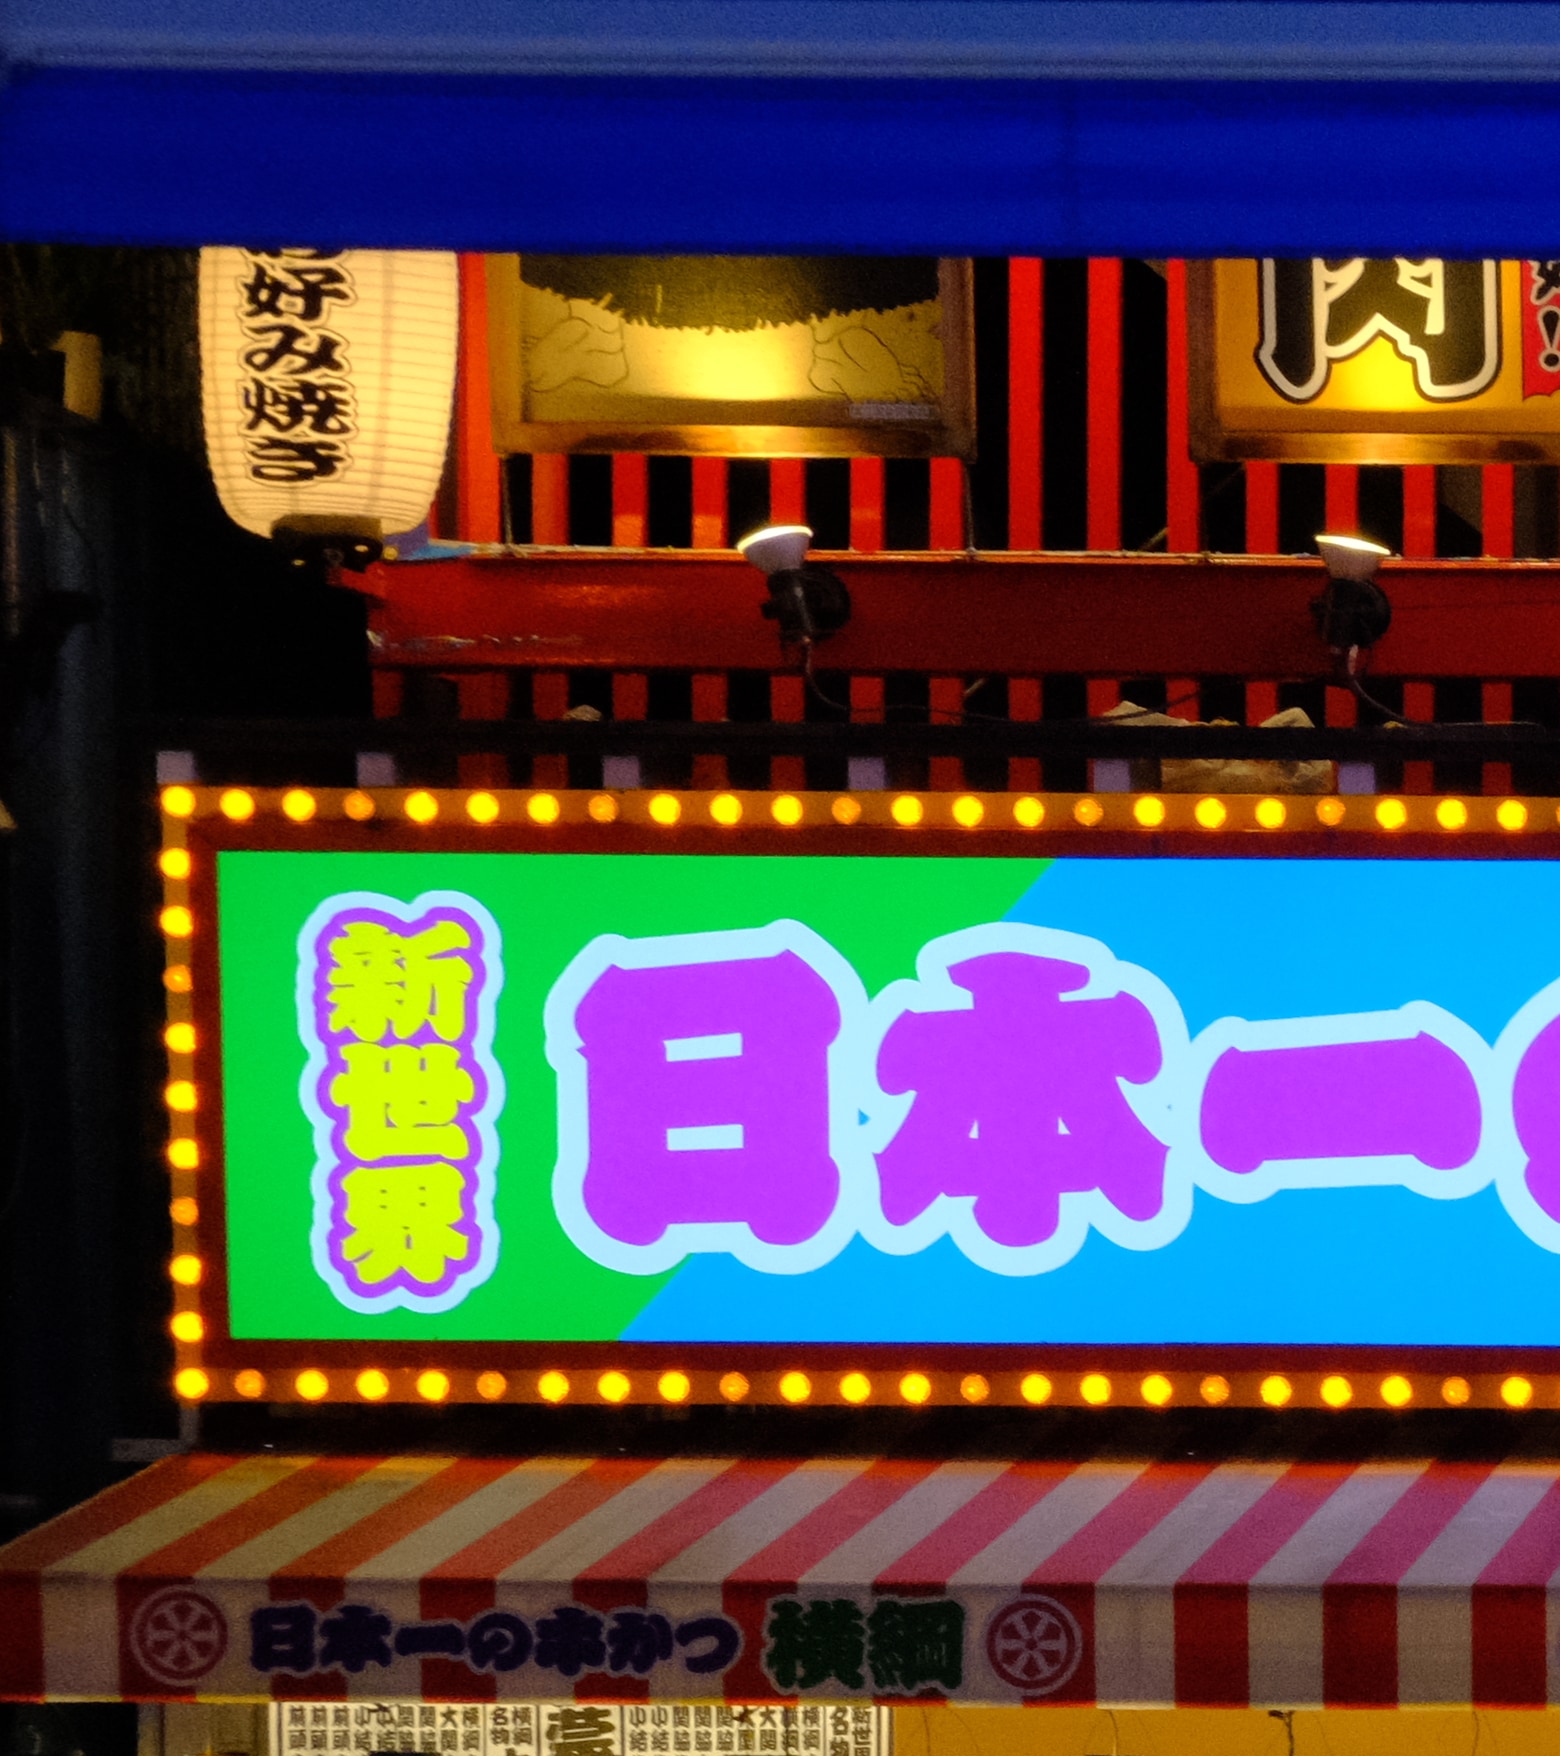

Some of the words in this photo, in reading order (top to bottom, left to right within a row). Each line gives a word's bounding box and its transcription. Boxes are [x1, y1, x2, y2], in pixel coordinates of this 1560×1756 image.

[243, 250, 356, 484] 好み焼き
[316, 906, 488, 1298] 新世界
[250, 1602, 742, 1678] 日本一の串かつ
[761, 1597, 967, 1692] 横綱
